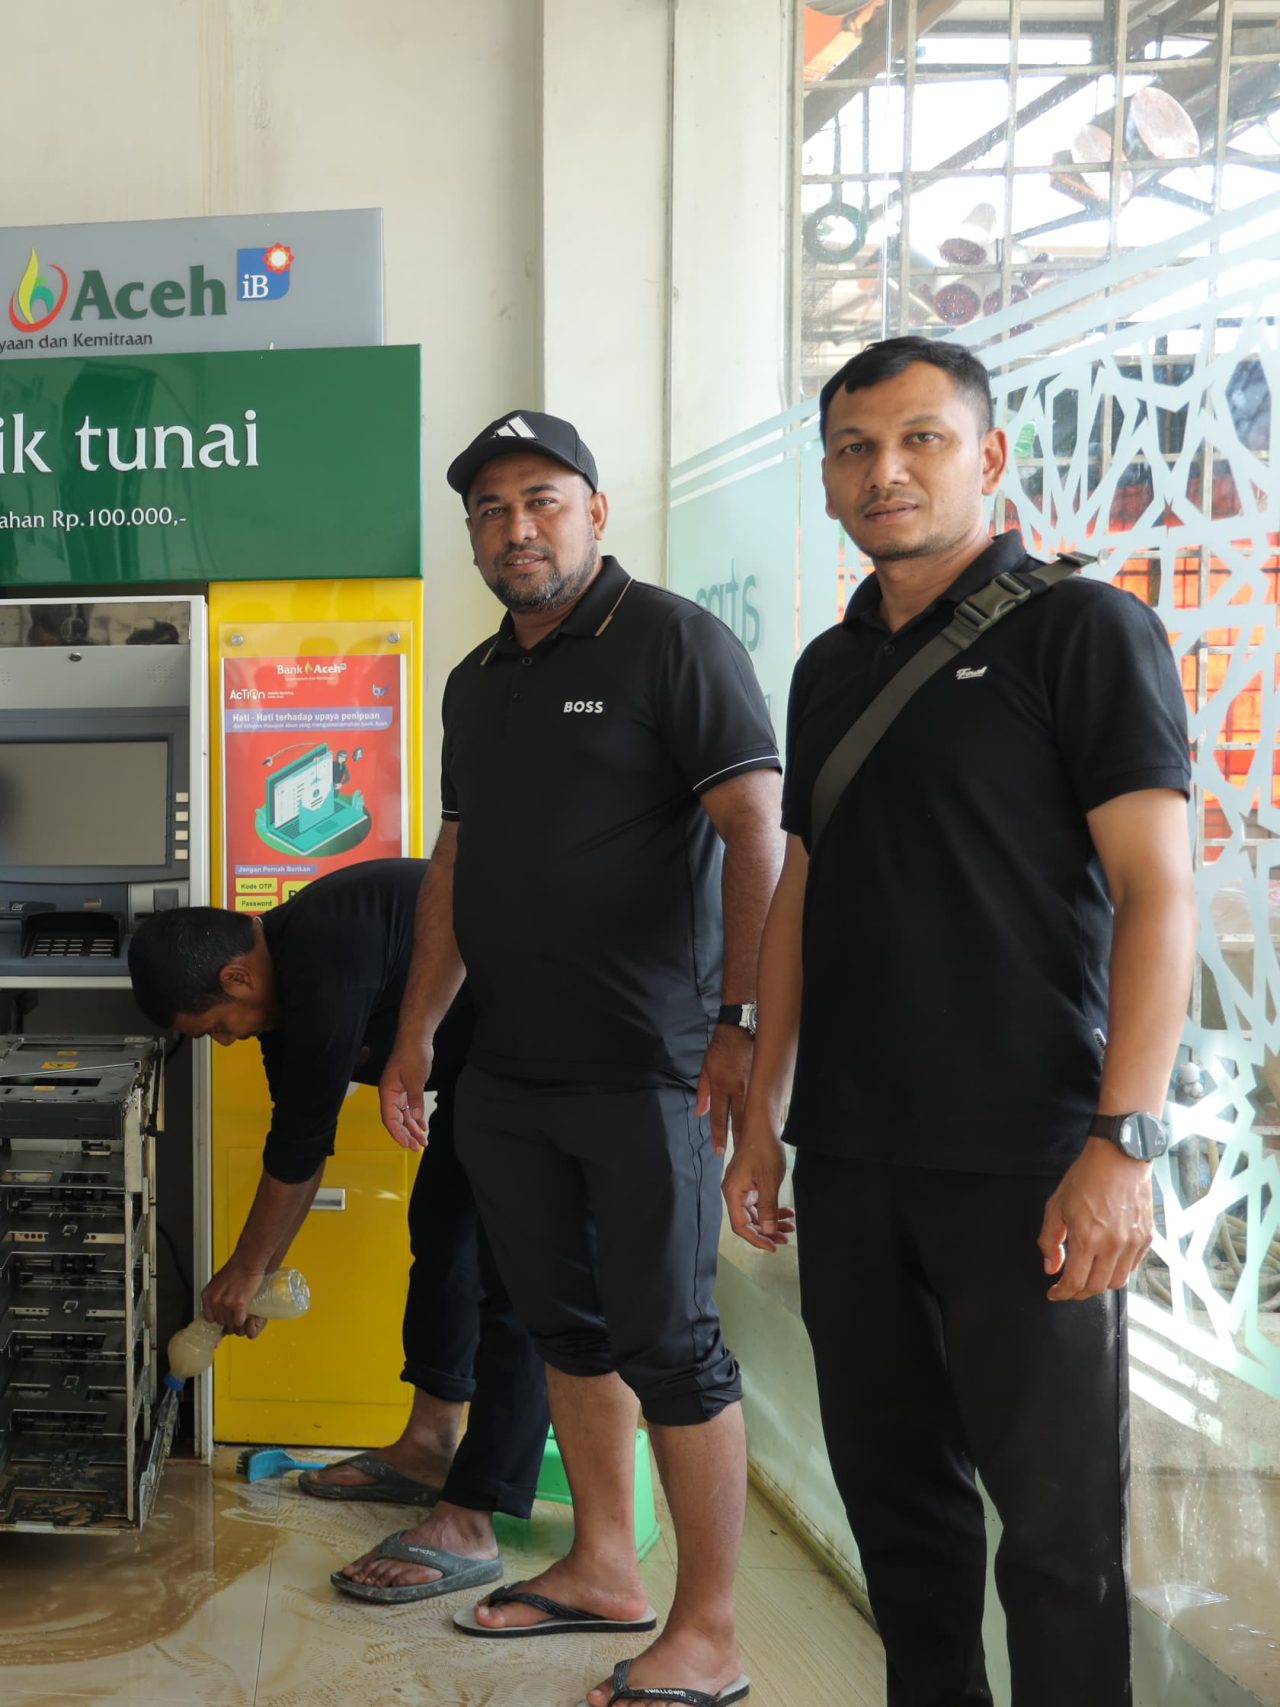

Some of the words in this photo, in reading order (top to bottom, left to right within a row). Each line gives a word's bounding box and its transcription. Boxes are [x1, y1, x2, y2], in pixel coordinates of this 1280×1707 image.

[70, 264, 227, 321] Aceh
[241, 273, 269, 299] iB
[38, 334, 68, 349] dan
[73, 332, 153, 347] Kemitraan
[74, 409, 260, 472] tunai
[52, 506, 188, 532] Rp.100.000,-
[277, 664, 304, 674] Bank
[313, 664, 340, 674] Aceh
[563, 700, 604, 714] BOSS
[232, 713, 251, 722] Hati
[256, 713, 274, 721] Hati
[276, 712, 313, 722] terhadap
[314, 713, 340, 722] upaya
[341, 711, 380, 721] penipuan
